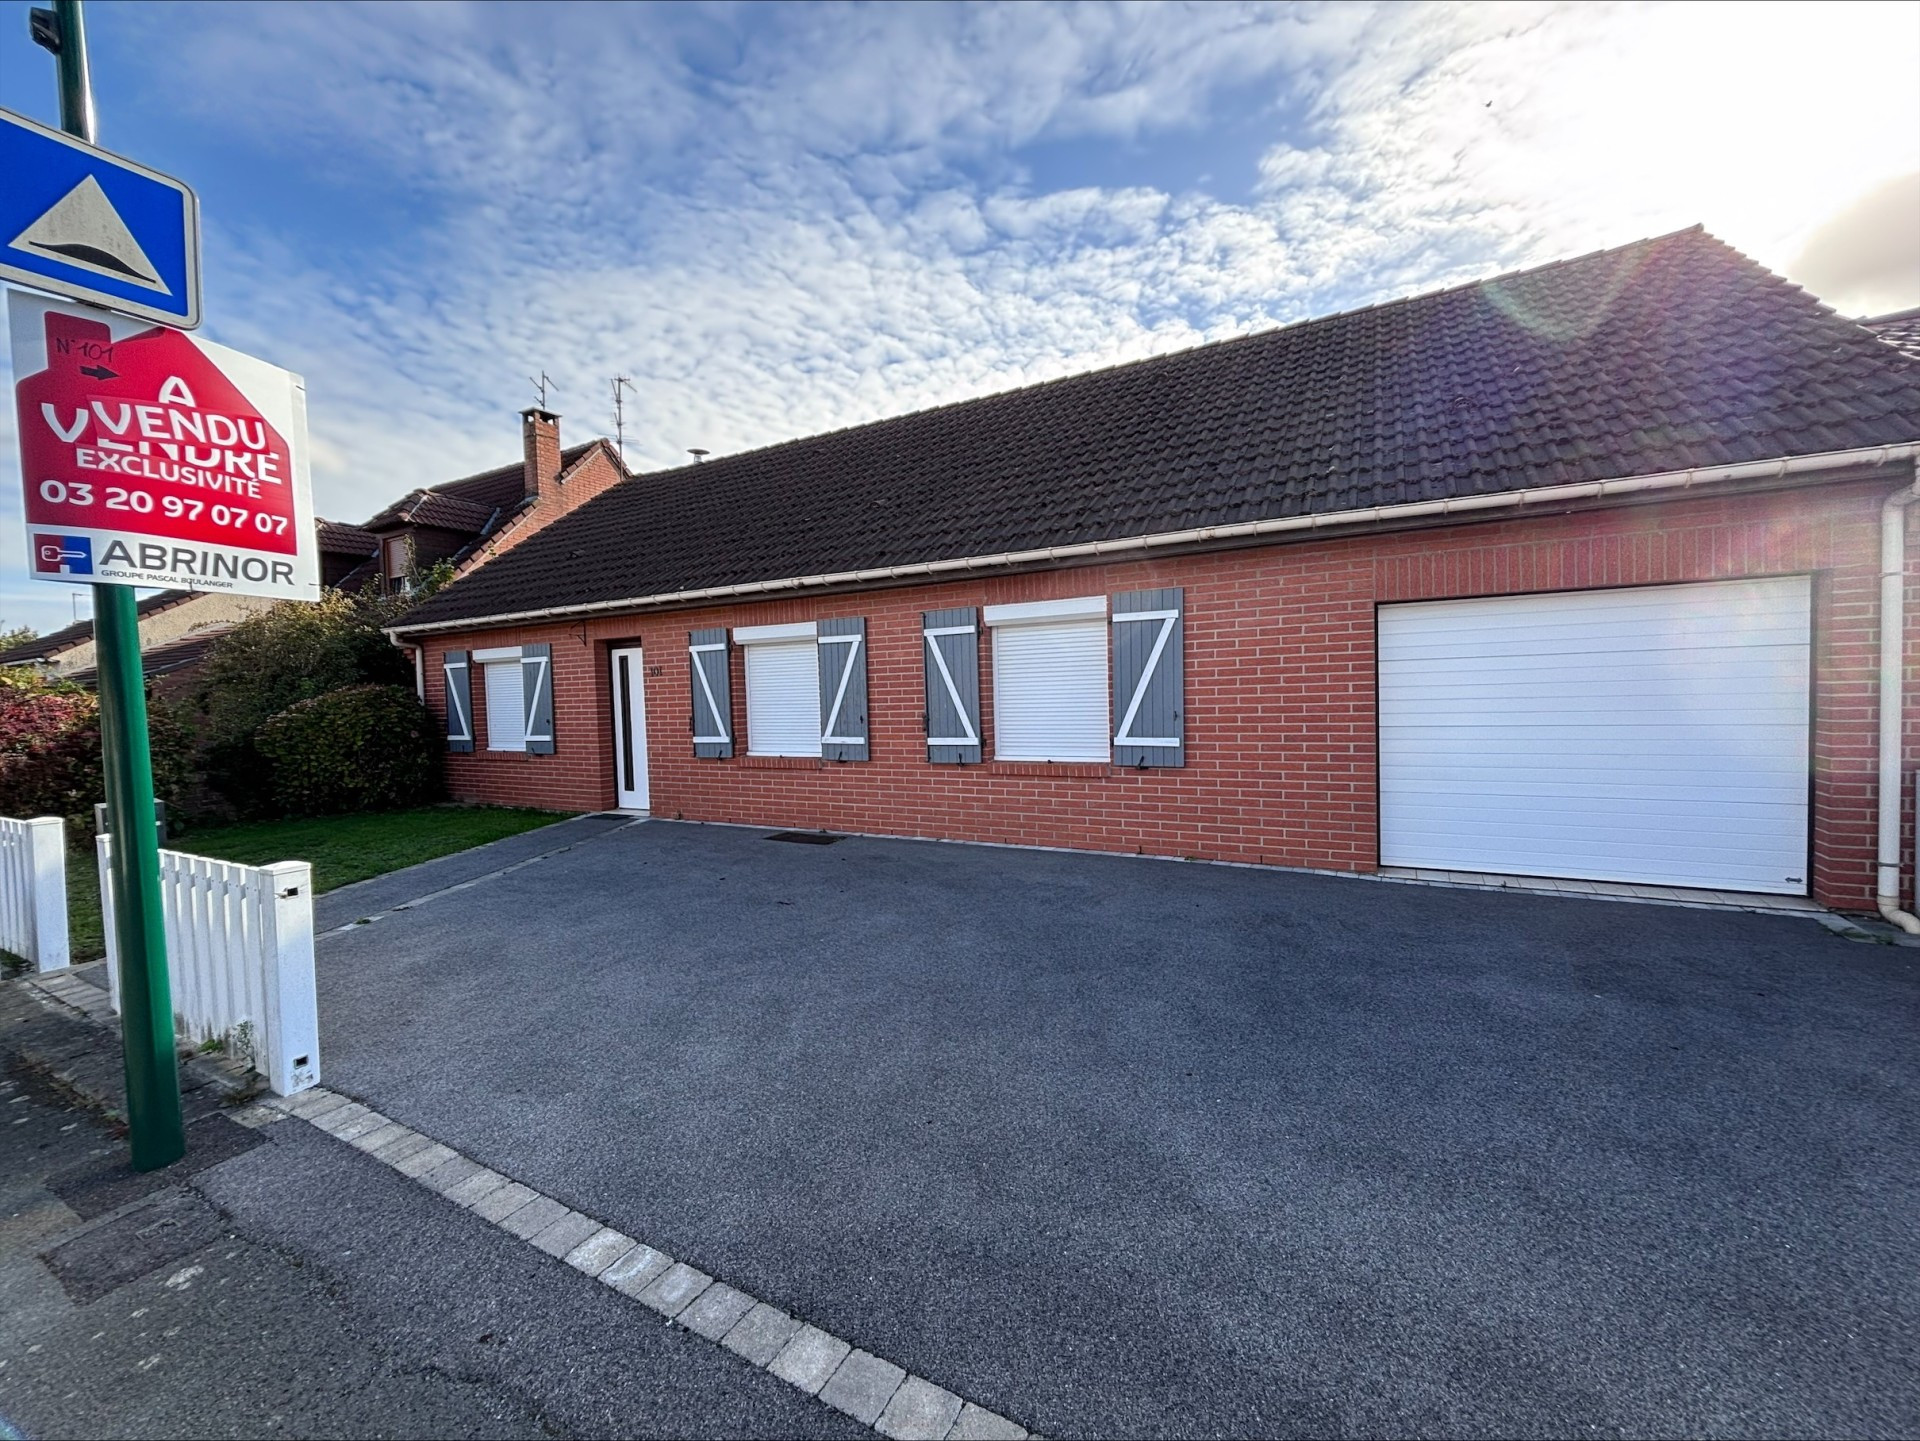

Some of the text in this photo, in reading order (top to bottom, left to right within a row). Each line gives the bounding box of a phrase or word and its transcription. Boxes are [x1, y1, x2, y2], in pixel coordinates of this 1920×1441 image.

[158, 375, 196, 408] A
[91, 400, 267, 450] VENDU
[75, 447, 263, 499] EXCLUSIVITÉ
[39, 479, 288, 536] 03 20 97 07 07
[99, 539, 295, 586] ABRINOR
[101, 569, 233, 589] GROUPE PASCAL BOULANGER
[650, 665, 663, 677] 101
